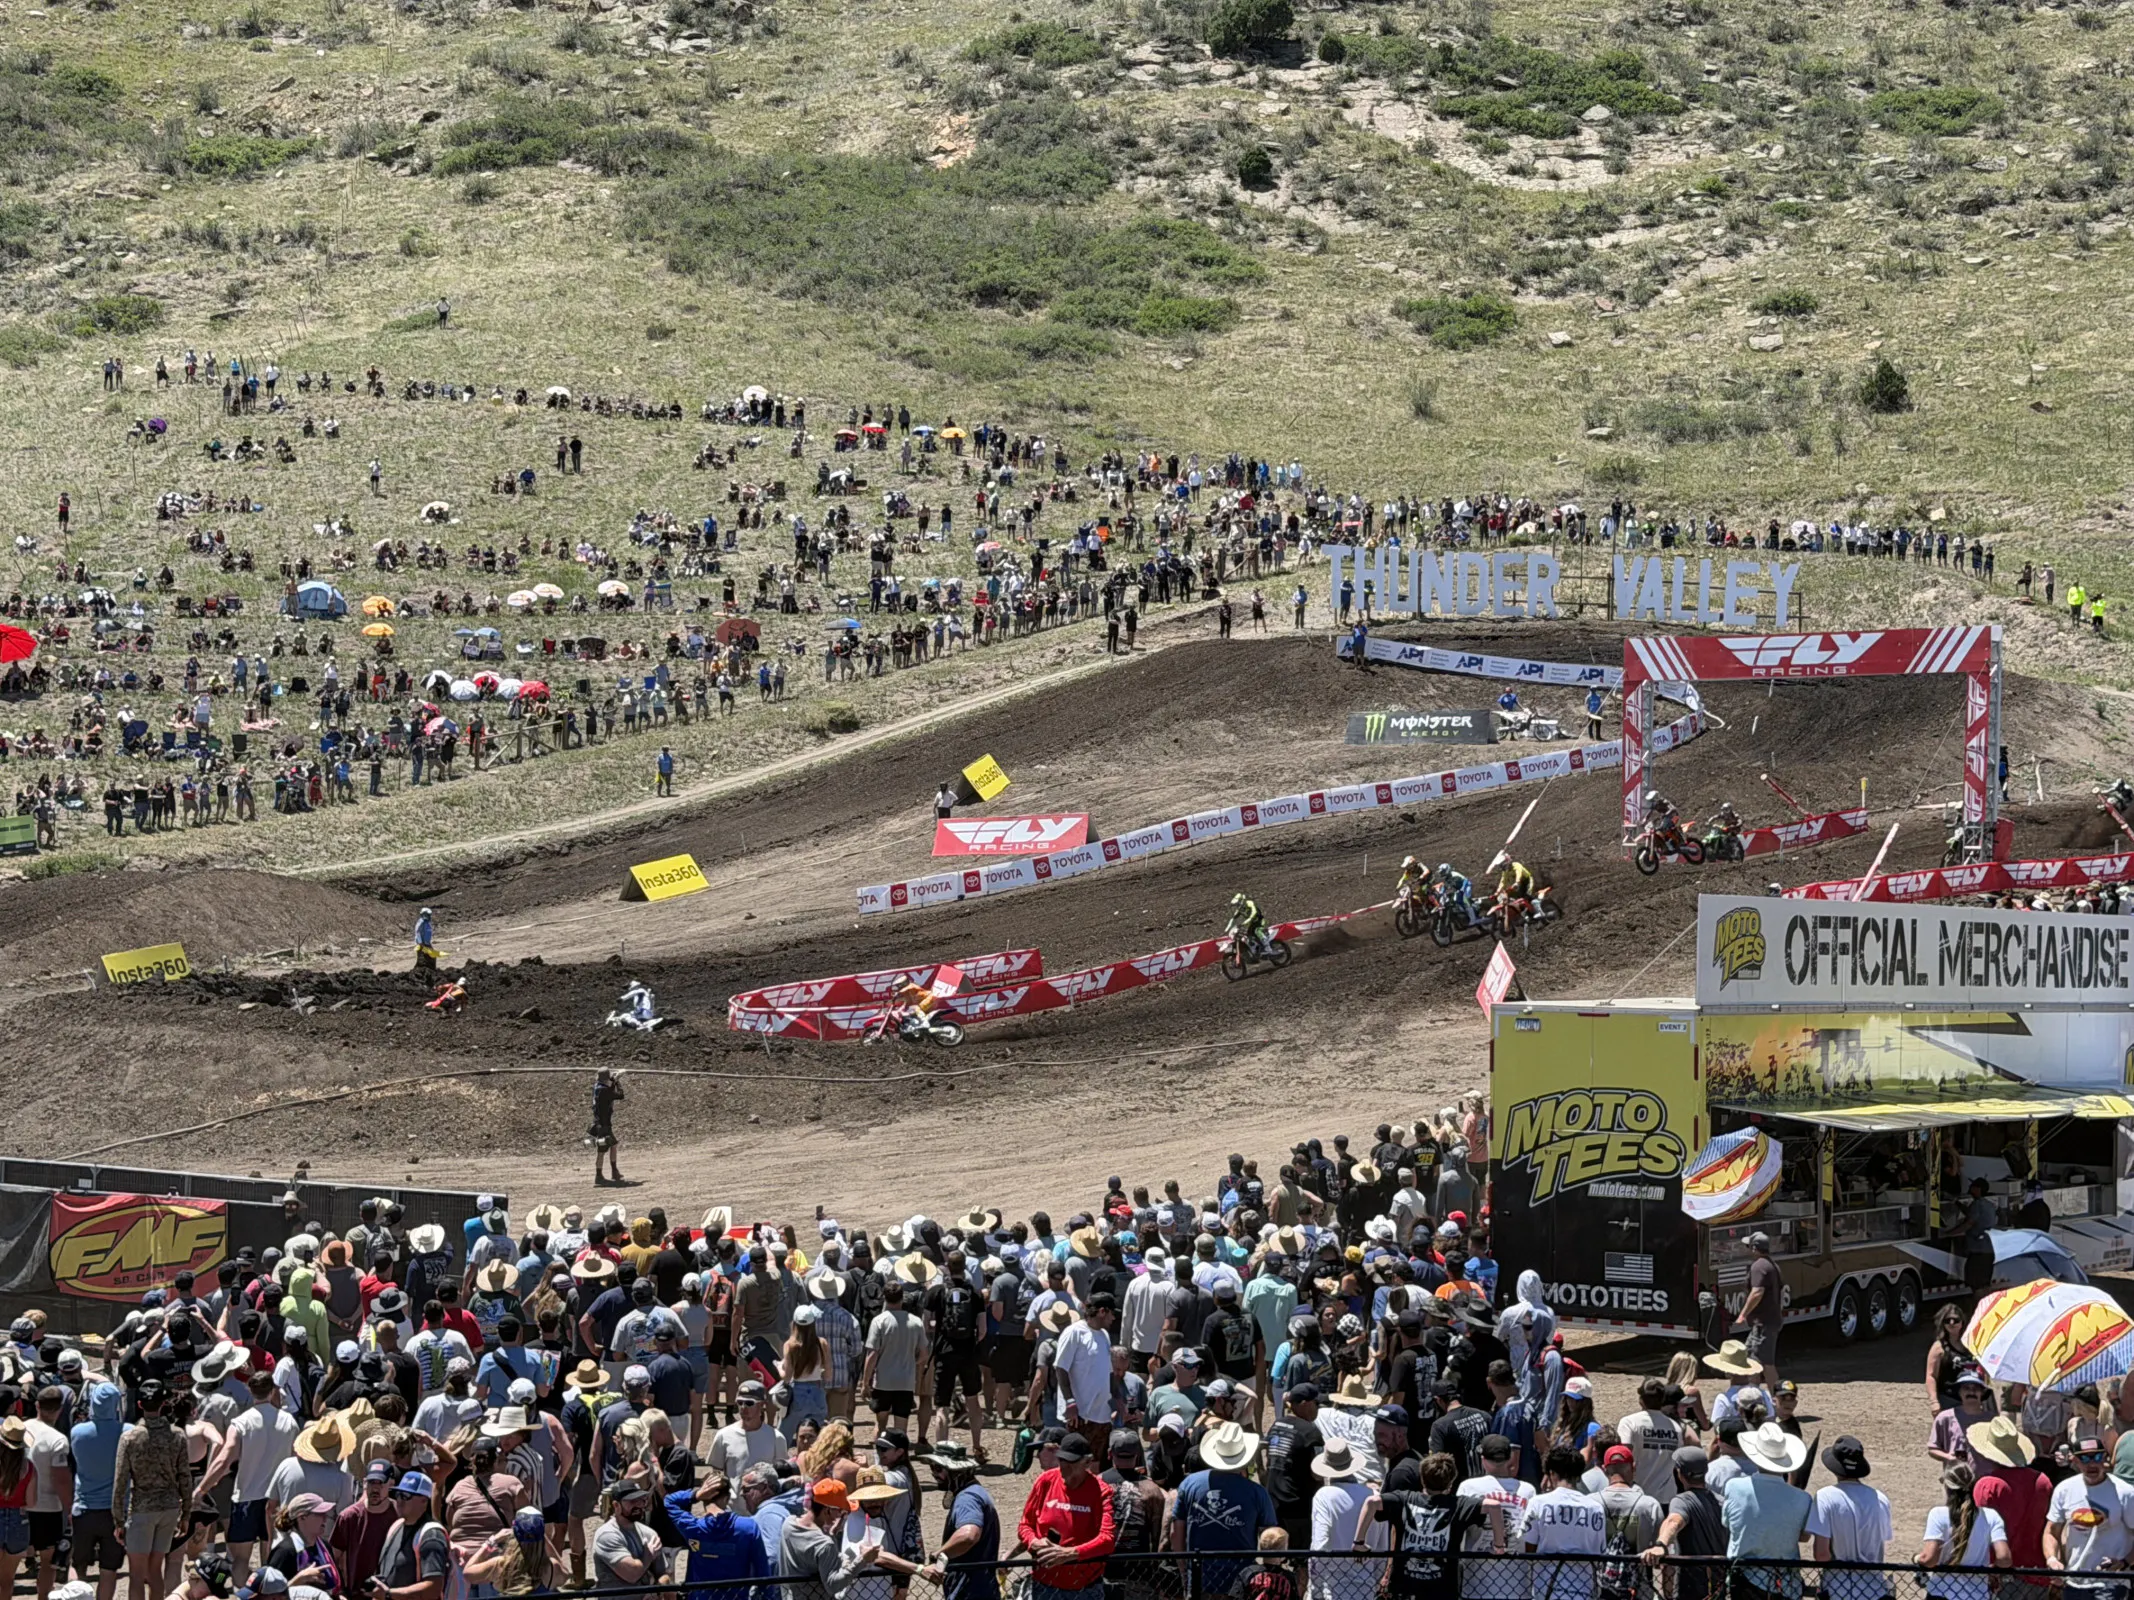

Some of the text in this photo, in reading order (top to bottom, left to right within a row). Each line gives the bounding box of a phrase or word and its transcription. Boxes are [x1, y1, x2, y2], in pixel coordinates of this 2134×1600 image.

[1321, 544, 1799, 627] THUNDER VALLEY
[1396, 646, 1424, 664] API
[1718, 632, 1886, 666] FLY
[1455, 655, 1484, 672] API
[1515, 663, 1544, 679] API
[1752, 666, 1848, 676] RACING
[1576, 668, 1605, 684] API
[1391, 715, 1473, 729] MONSTER
[1585, 747, 1620, 760] TOYOTA
[1522, 759, 1560, 774] TOYOTA
[970, 764, 1003, 790] Insta360
[1458, 770, 1494, 786] TOYOTA
[1393, 781, 1432, 796] TOYOTA
[1328, 791, 1367, 806] TOYOTA
[1260, 802, 1300, 818] TOYOTA
[942, 817, 1082, 844] FLY
[1191, 814, 1231, 832] TOYOTA
[1771, 817, 1827, 841] FLY
[968, 843, 1049, 852] RACING
[1122, 832, 1163, 851] TOYOTA
[1053, 851, 1093, 870] TOYOTA
[2075, 855, 2131, 876] FLY
[639, 864, 699, 889] Insta360
[984, 867, 1023, 885] TOYOTA
[1941, 865, 1989, 887] FLY
[2001, 861, 2066, 880] FLY
[911, 880, 952, 897] TOYOTA
[1887, 872, 1935, 895] FLY
[1714, 909, 1761, 961] MOTO
[1130, 946, 1200, 977] FLY
[1720, 935, 1766, 985] TEES
[1784, 915, 2129, 989] OFFICIAL MERCHANDISE
[953, 953, 1033, 978] FLY
[1048, 967, 1115, 996] FLY
[762, 982, 836, 1007] FLY
[945, 986, 1030, 1015] FLY
[1504, 1091, 1663, 1164] MOTO
[1530, 1132, 1682, 1202] TEES
[1587, 1181, 1666, 1200] mototees.com
[55, 1213, 226, 1281] FMF
[1544, 1282, 1669, 1312] MOTOTEES
[1643, 1428, 1679, 1440] CMMX
[1056, 1501, 1091, 1512] HONDA
